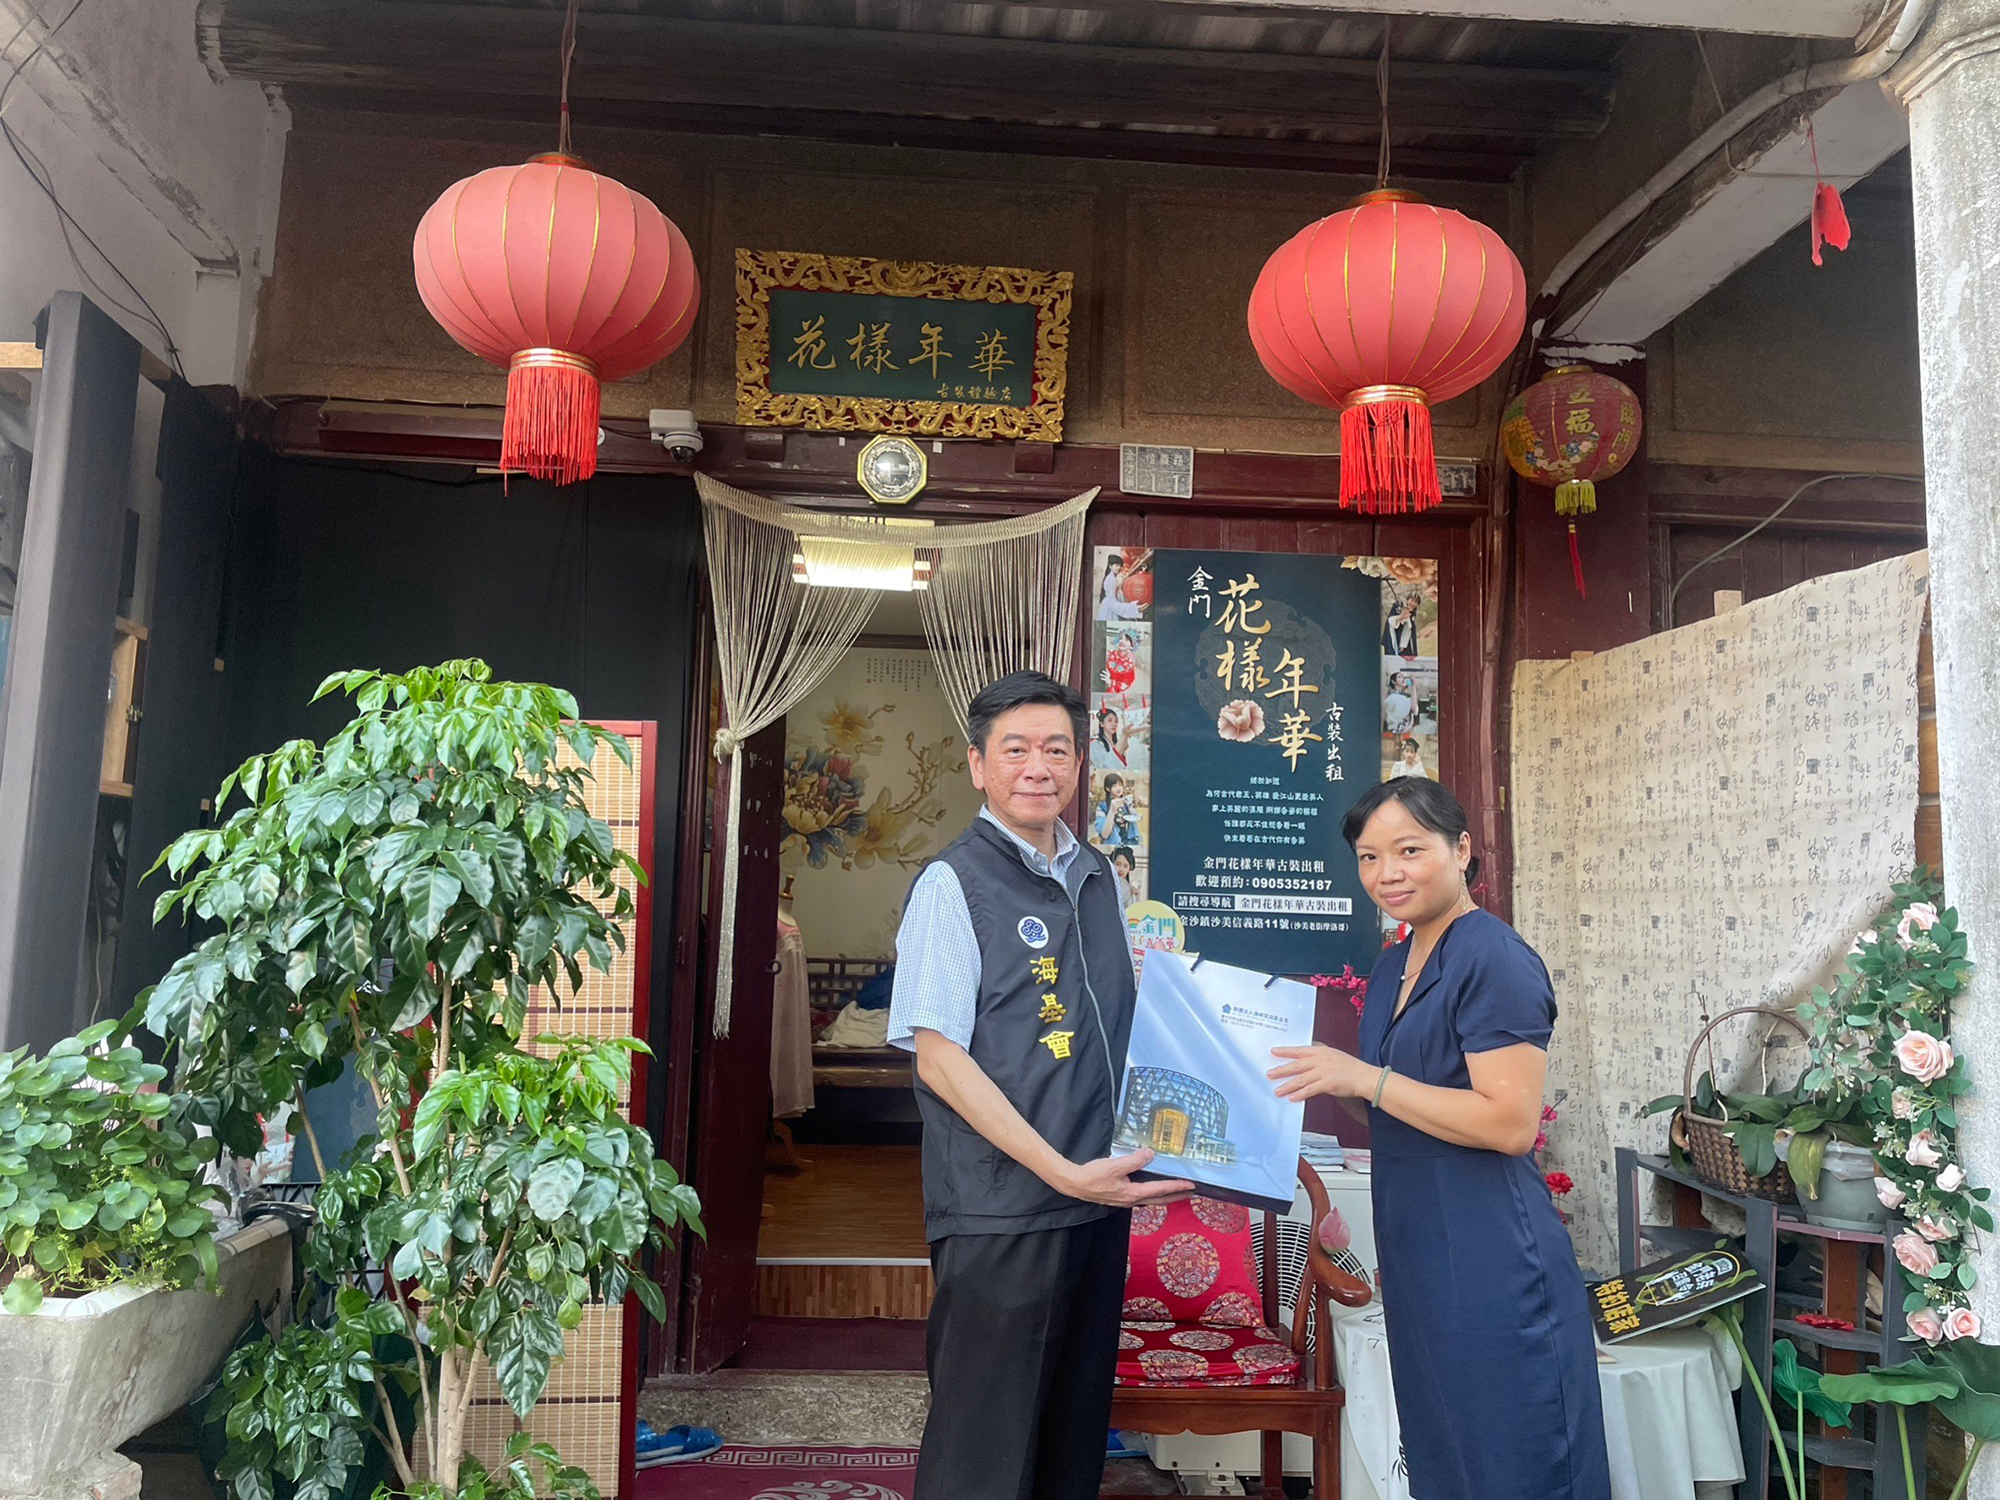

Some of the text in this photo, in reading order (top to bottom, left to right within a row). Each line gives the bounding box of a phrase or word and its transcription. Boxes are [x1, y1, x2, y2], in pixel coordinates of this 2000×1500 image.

[786, 314, 1016, 383] 花樣年華
[1187, 564, 1214, 619] 金門
[1324, 701, 1345, 783] 古裝出租
[1203, 856, 1325, 873] 金門花樣年華古裝出租
[1177, 894, 1348, 912] 請搜尋導航 金門花樣年華古裝出租
[1029, 955, 1075, 1060] 海基會
[1592, 1278, 1642, 1335] 特約店家
